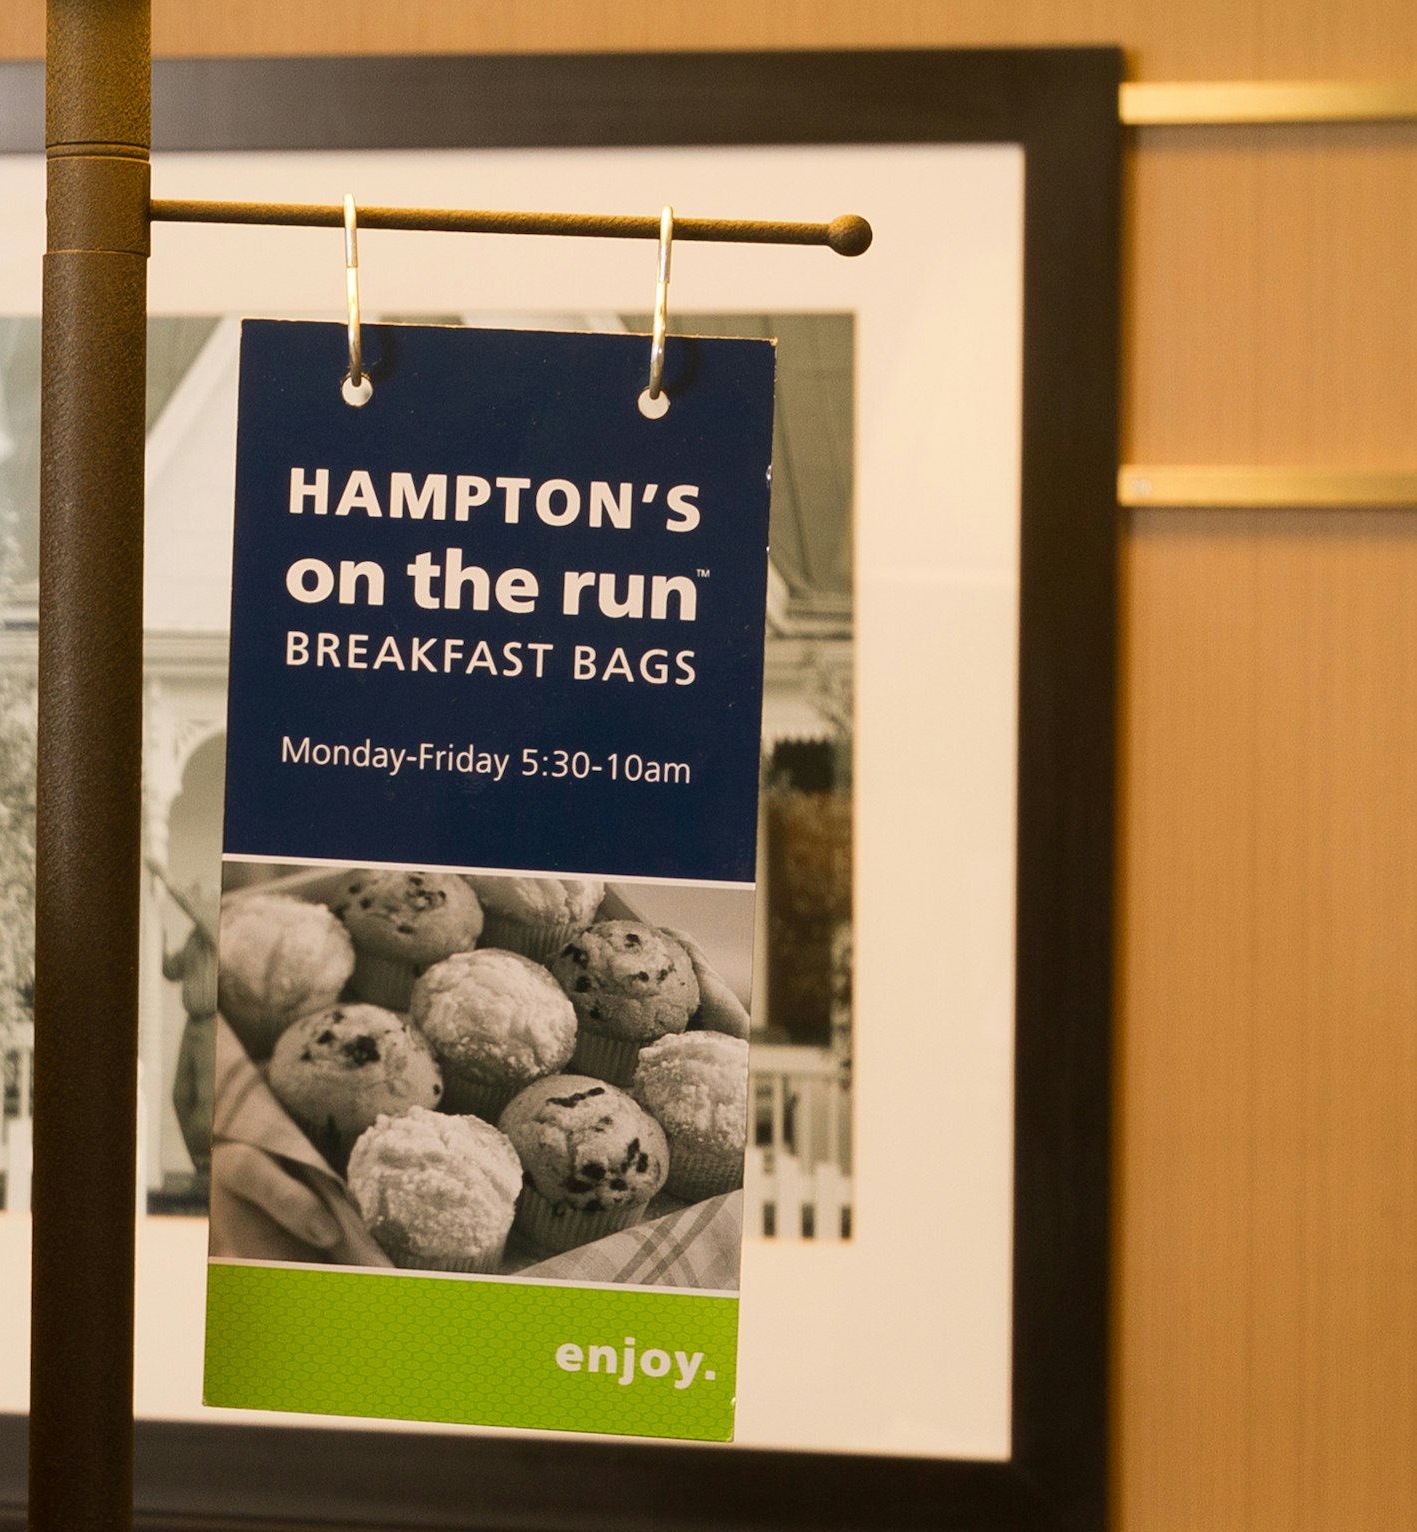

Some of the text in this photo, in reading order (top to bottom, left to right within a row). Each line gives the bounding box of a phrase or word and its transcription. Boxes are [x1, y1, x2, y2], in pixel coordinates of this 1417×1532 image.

[286, 557, 385, 606] on
[407, 548, 540, 614] the
[286, 630, 696, 686] BREAKFAST BAGS
[281, 736, 691, 784] Monday-Friday 5:30-10am
[555, 1337, 717, 1390] enjoy.
